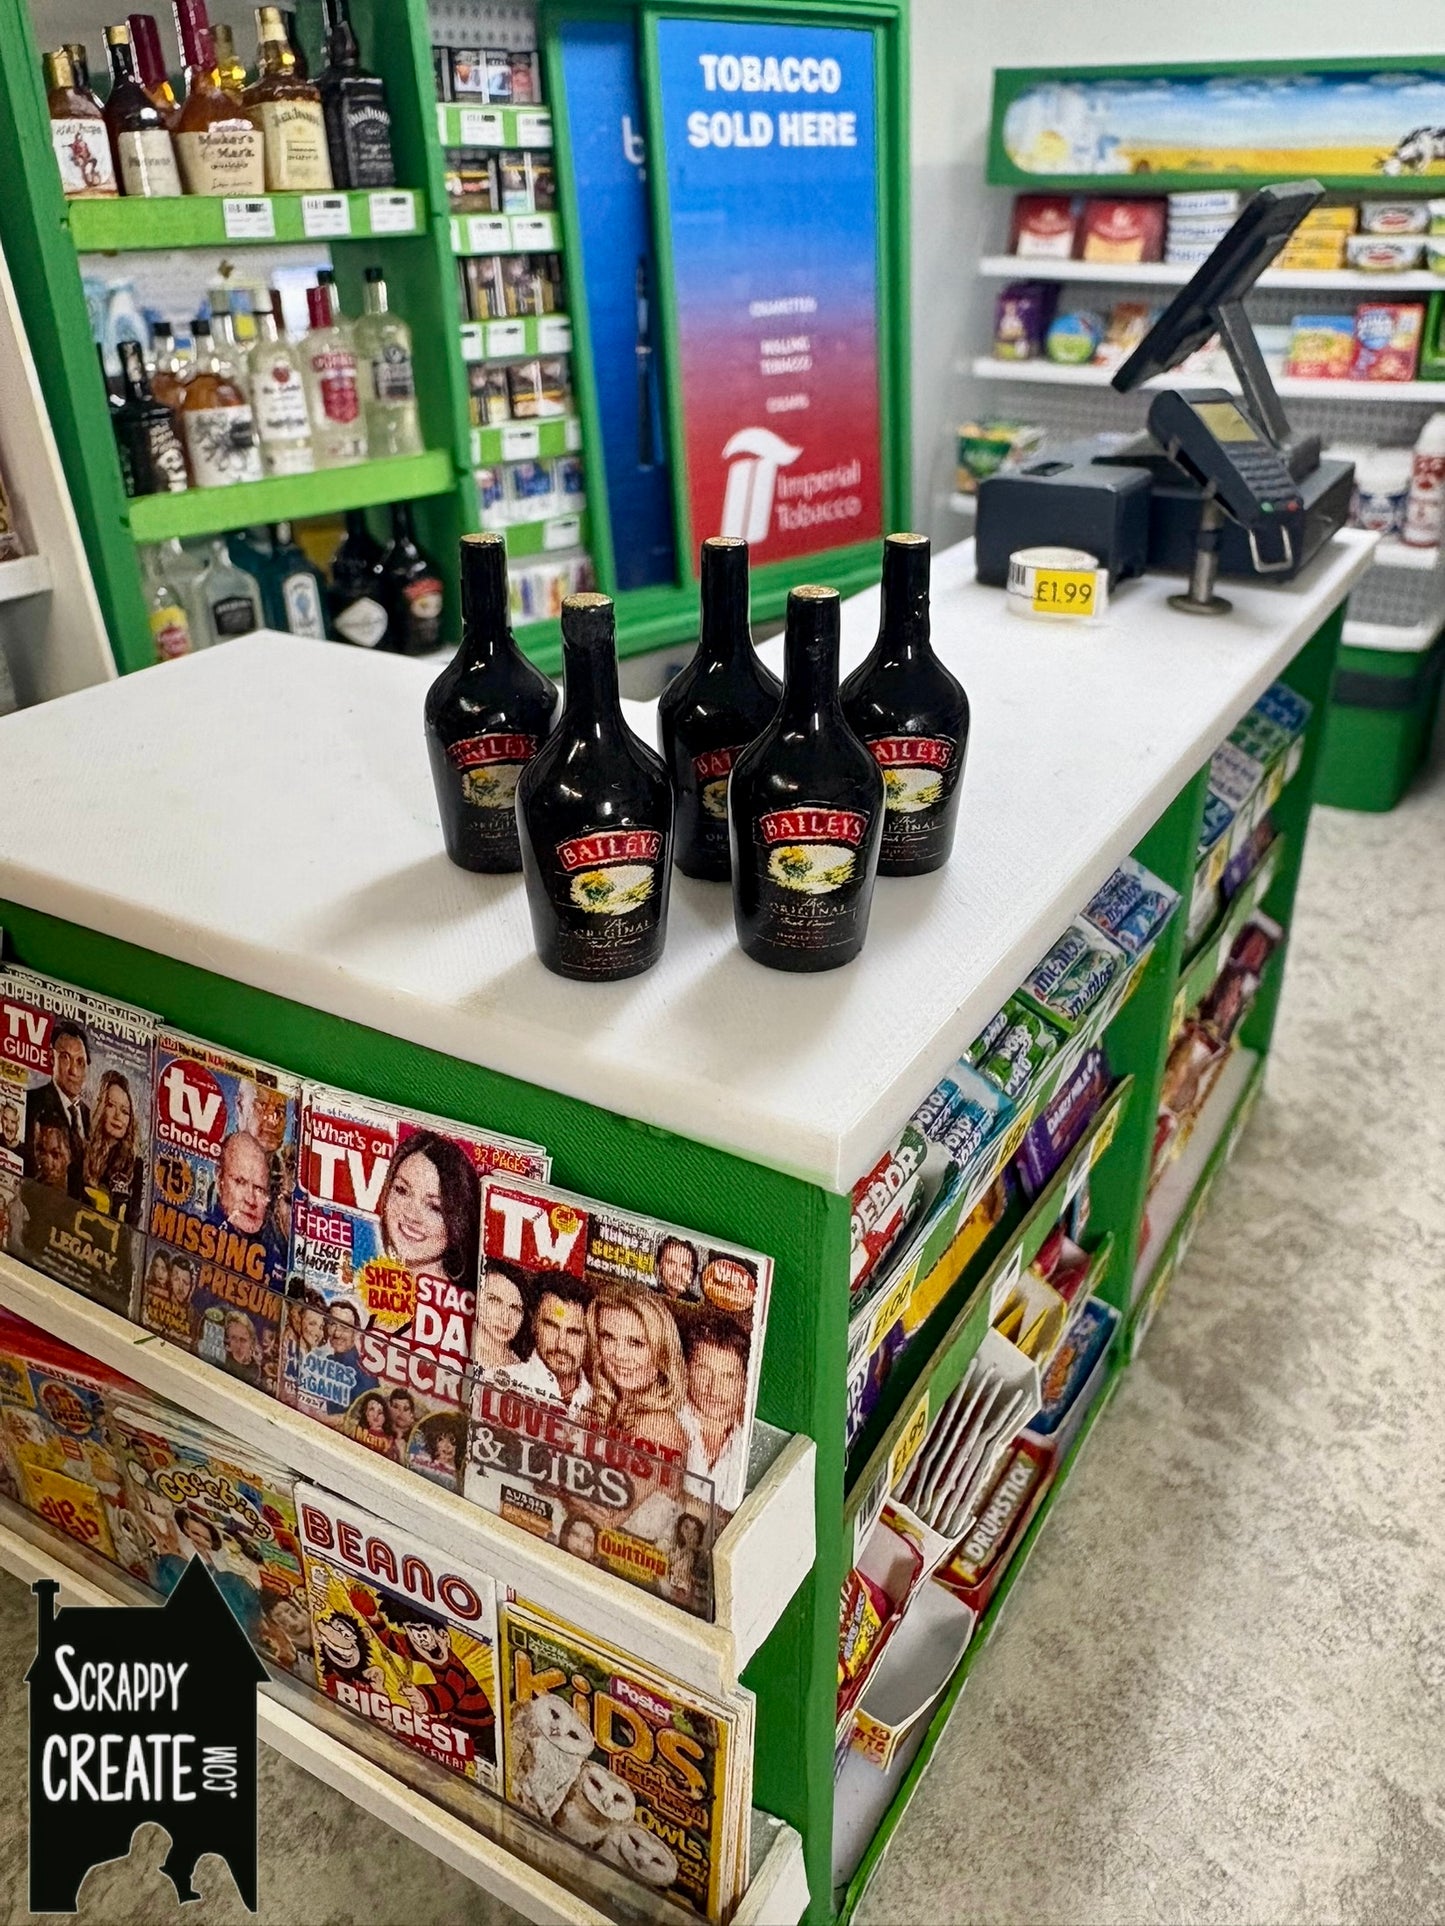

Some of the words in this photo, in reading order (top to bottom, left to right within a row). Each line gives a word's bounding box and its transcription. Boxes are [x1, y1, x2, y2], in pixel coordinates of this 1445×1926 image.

[698, 53, 842, 95] TOBACCO
[687, 111, 774, 149] SOLD
[778, 112, 858, 147] HERE
[1037, 580, 1092, 604] £1.99
[874, 742, 950, 768] AILEYS
[765, 813, 863, 842] BAILEYS
[3, 1003, 49, 1046] TV
[43, 994, 84, 1024] BOWL
[86, 1010, 149, 1047] PREVIEW
[3, 1036, 49, 1068] GUIDE
[163, 1065, 223, 1135] tv
[159, 1122, 222, 1157] choice
[312, 1118, 367, 1151] What's
[371, 1139, 393, 1158] on
[156, 1157, 186, 1192] 75
[311, 1139, 391, 1213] TV
[492, 1151, 529, 1174] PAGES
[306, 1214, 352, 1246] FREE
[313, 1239, 343, 1257] LEGO
[489, 1192, 584, 1271] TV
[50, 1226, 119, 1275] LEGACY
[364, 1265, 412, 1292] SHE'S
[368, 1289, 414, 1316] BACK
[472, 1426, 506, 1468] &
[964, 1460, 1036, 1559] DRUMSTICK
[301, 1503, 484, 1622] BEANO
[335, 1680, 470, 1757] BIGGEST
[616, 1677, 674, 1723] Poster
